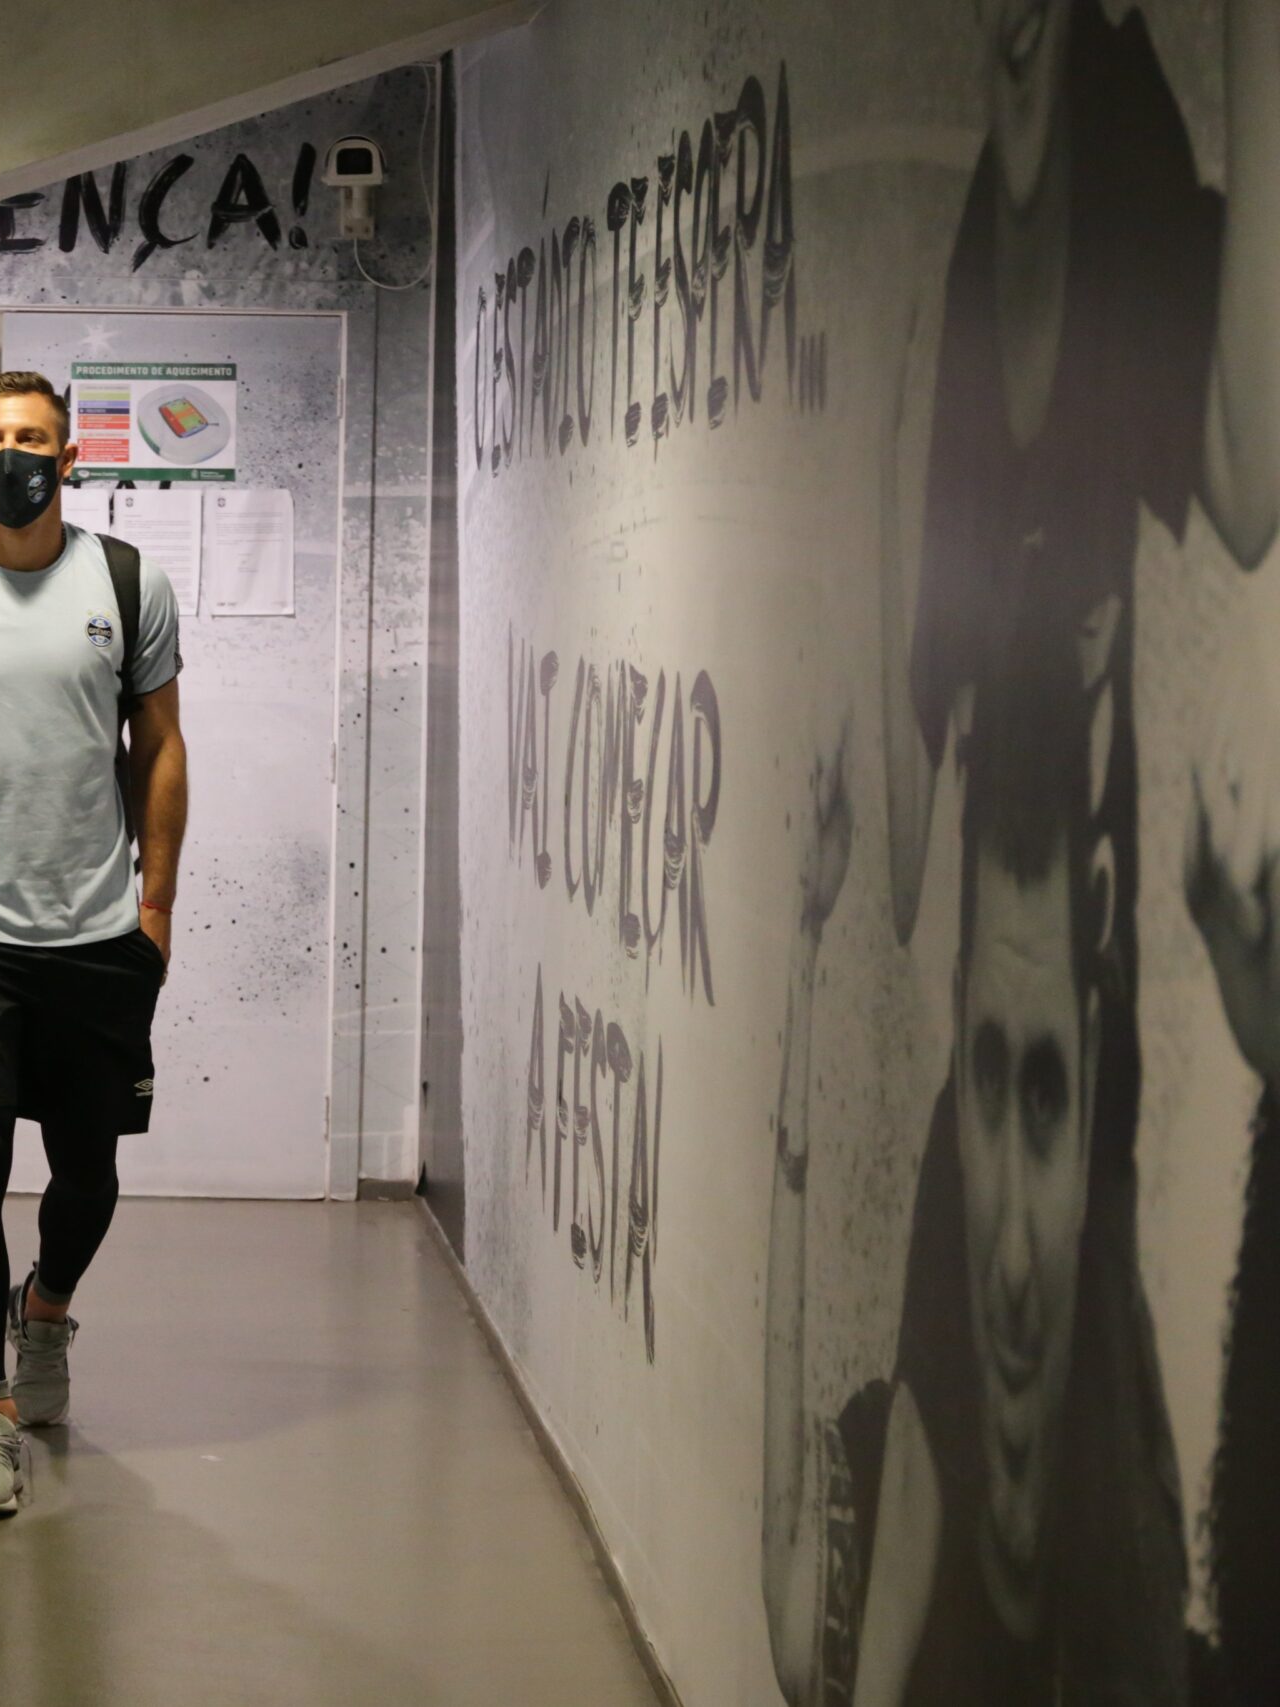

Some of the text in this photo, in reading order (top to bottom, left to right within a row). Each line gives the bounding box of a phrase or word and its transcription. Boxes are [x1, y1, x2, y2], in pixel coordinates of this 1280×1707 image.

[76, 366, 232, 377] PROCEDIMENTO DE AQUECIMENTO
[491, 168, 596, 477] ESTÁDIO
[607, 177, 649, 448] TE
[508, 618, 721, 1006] VAI COMEÇAR
[525, 962, 547, 1214] A
